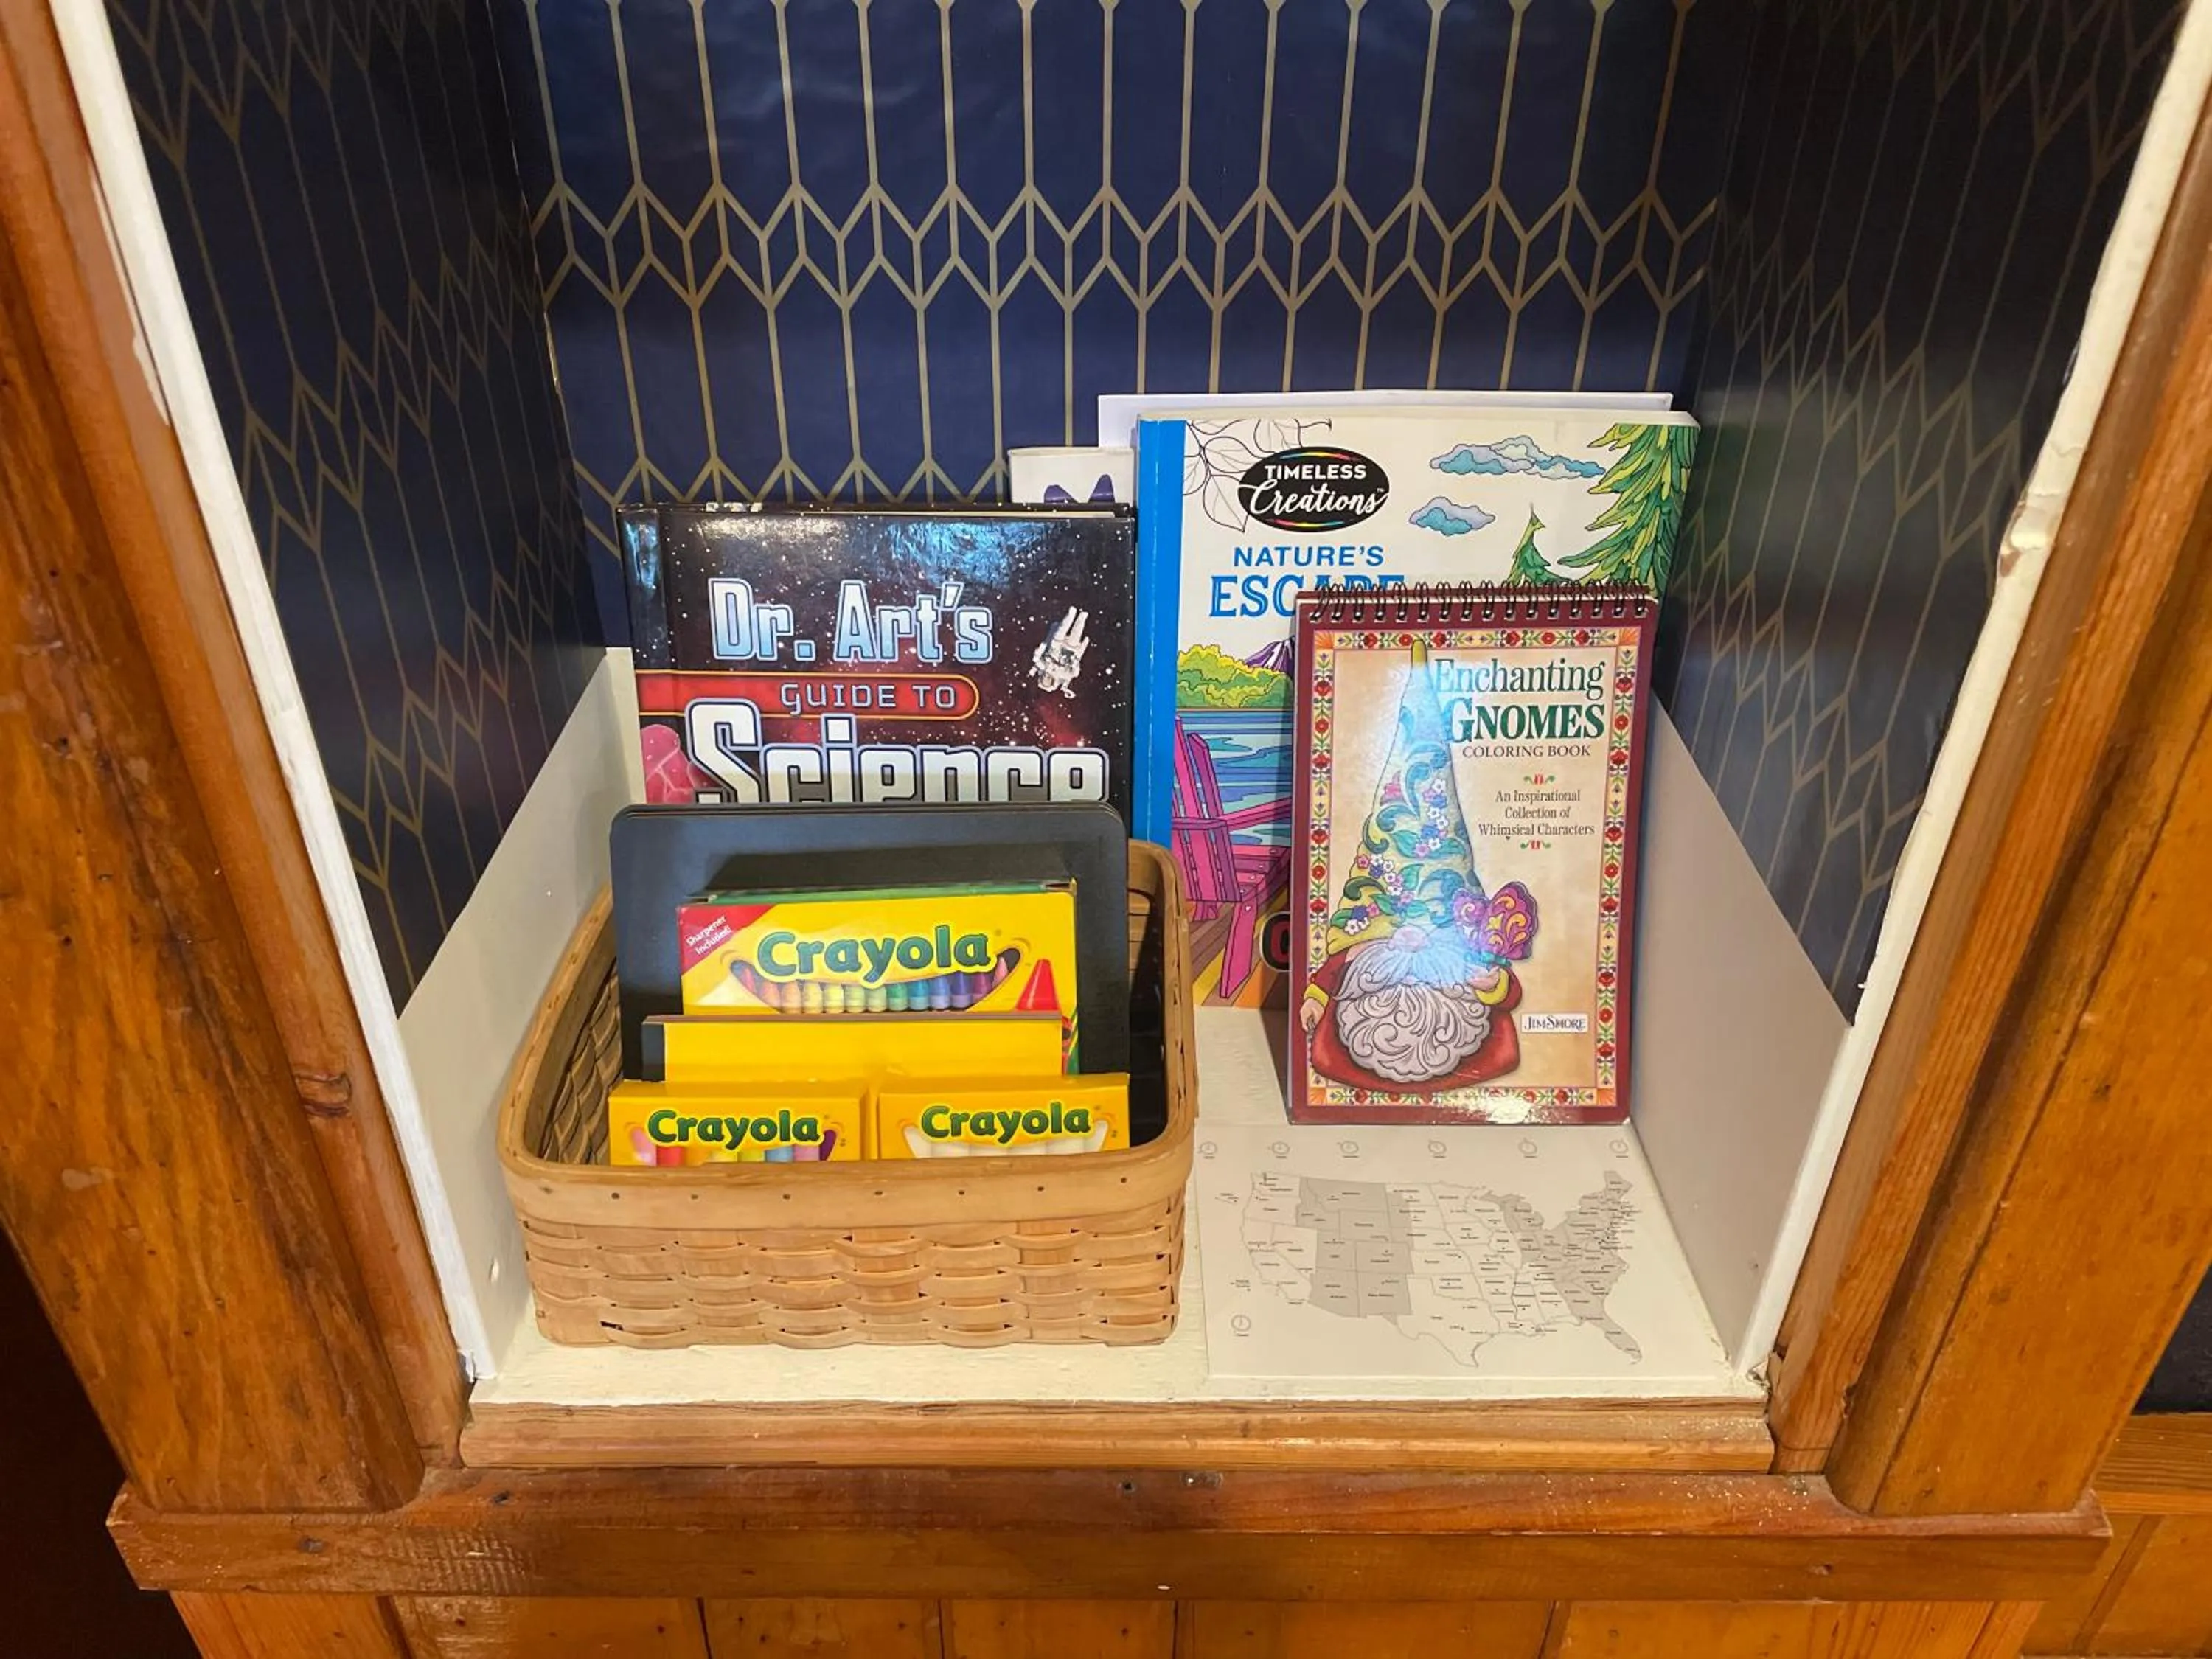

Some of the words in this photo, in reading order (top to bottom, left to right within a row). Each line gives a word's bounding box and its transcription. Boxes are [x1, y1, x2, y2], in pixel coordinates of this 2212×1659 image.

[1265, 465, 1366, 480] TIMELESS
[1239, 479, 1388, 515] Creations
[1234, 546, 1384, 567] NATURE'S
[709, 578, 815, 661] Dr.
[833, 580, 993, 662] Art's
[1435, 658, 1606, 700] Enchanting
[780, 683, 897, 716] GUIDE
[911, 685, 956, 709] TO
[1441, 698, 1605, 743] GNOMES
[684, 697, 1110, 804] Science
[1462, 745, 1543, 758] COLORING
[1548, 745, 1591, 757] BOOK
[1495, 790, 1511, 802] An
[1514, 790, 1581, 805] Inspirational
[1505, 807, 1557, 819] Collection
[1559, 807, 1571, 818] of
[1478, 824, 1534, 836] Whimsical
[1537, 823, 1595, 835] Characters
[757, 924, 992, 984] Crayola
[648, 1110, 820, 1150] Crayola
[921, 1101, 1091, 1144] Crayola
